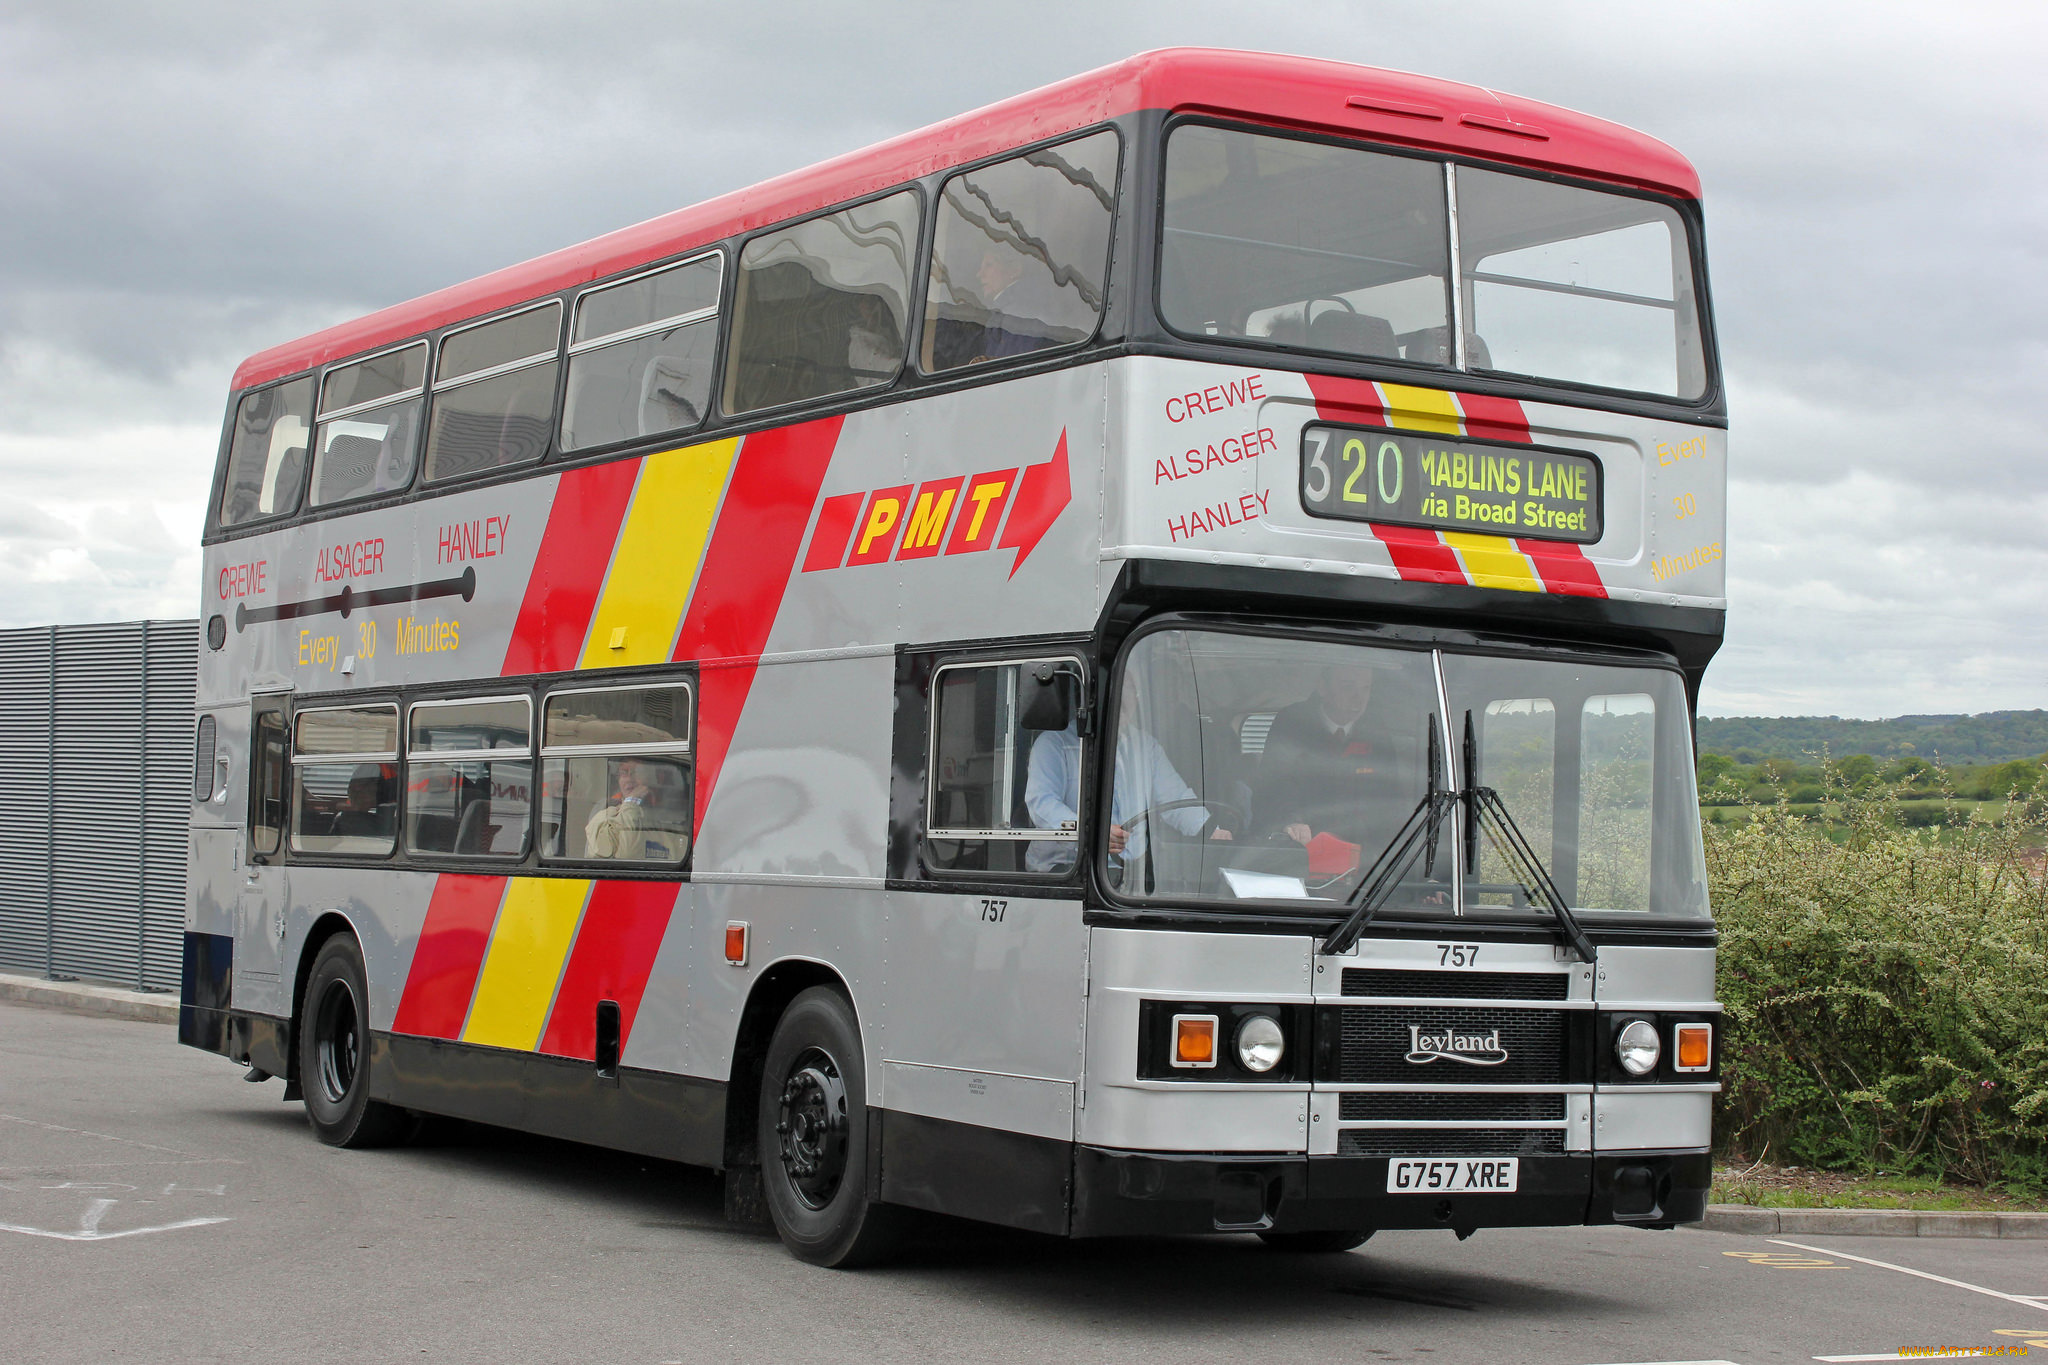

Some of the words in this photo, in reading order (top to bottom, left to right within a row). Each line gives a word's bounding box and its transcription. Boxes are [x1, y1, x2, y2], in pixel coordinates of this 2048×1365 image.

[1165, 374, 1267, 423] CREWE
[1155, 427, 1278, 485] ALSAGER
[1305, 430, 1403, 504] 320
[1656, 434, 1707, 467] Every
[1421, 450, 1521, 495] MABLINS
[1528, 460, 1588, 501] LANE
[857, 481, 1006, 555] PMT
[1168, 489, 1270, 542] HANLEY
[1421, 492, 1448, 518] via
[1455, 495, 1517, 525] Broad
[1523, 501, 1587, 531] Street
[1672, 492, 1697, 520] 30
[219, 560, 267, 600] CREWE
[315, 537, 384, 583] ALSAGER
[438, 514, 511, 565] HANLEY
[1651, 542, 1722, 583] Minutes
[298, 630, 340, 672] Every
[358, 620, 377, 659] 30
[395, 616, 460, 655] Minutes
[981, 900, 1007, 922] 757
[1437, 945, 1479, 967] 757
[1406, 1025, 1508, 1064] Leyland
[1396, 1162, 1459, 1188] G757
[1465, 1162, 1511, 1188] XRE
